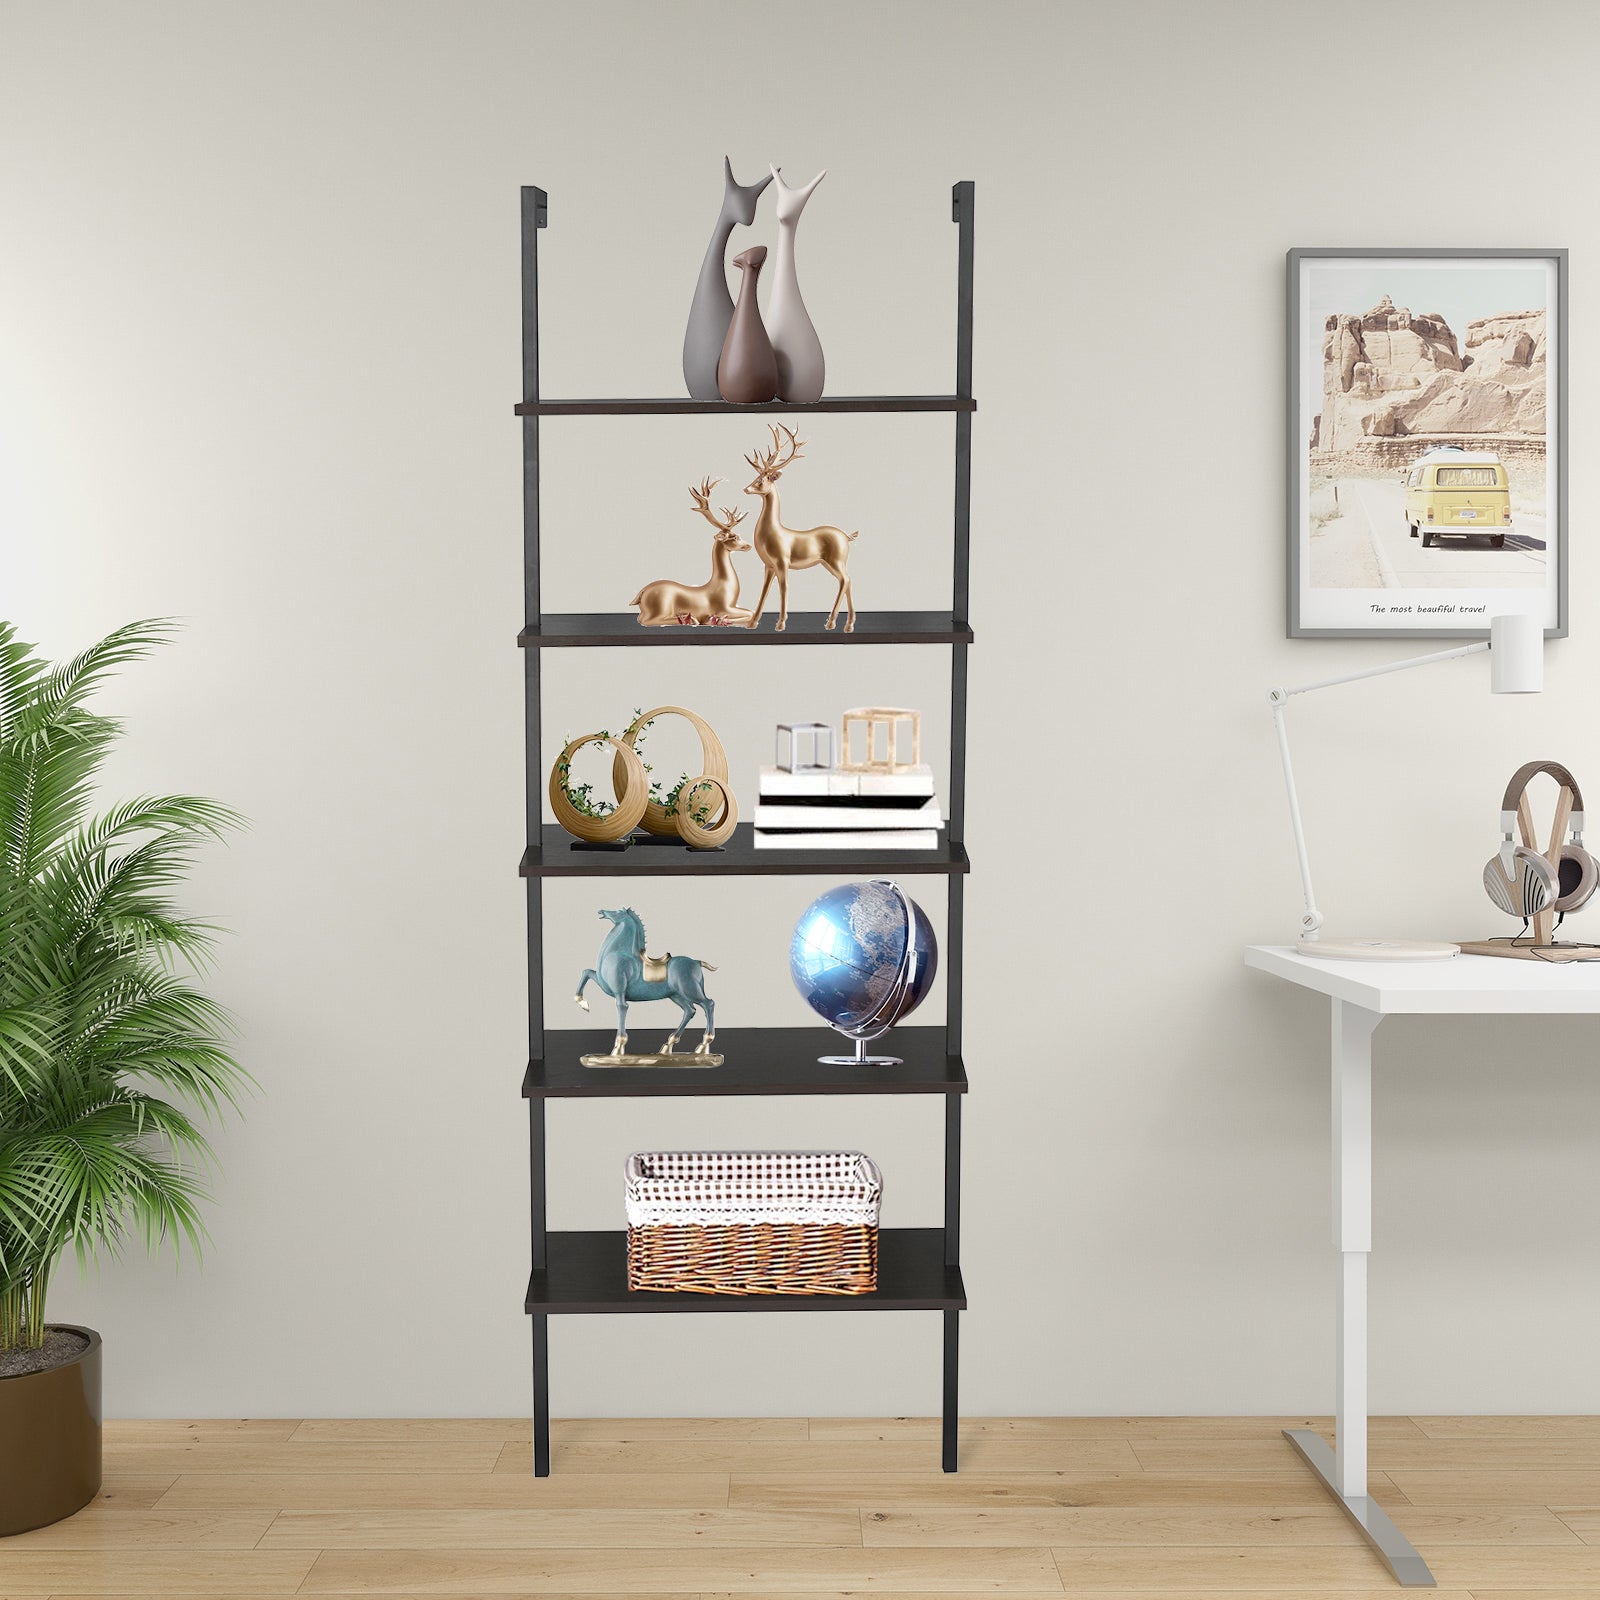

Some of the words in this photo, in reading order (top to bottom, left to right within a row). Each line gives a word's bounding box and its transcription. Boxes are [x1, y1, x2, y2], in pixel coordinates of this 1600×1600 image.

[1370, 604, 1386, 613] The
[1390, 605, 1413, 613] most
[1460, 604, 1486, 613] travel
